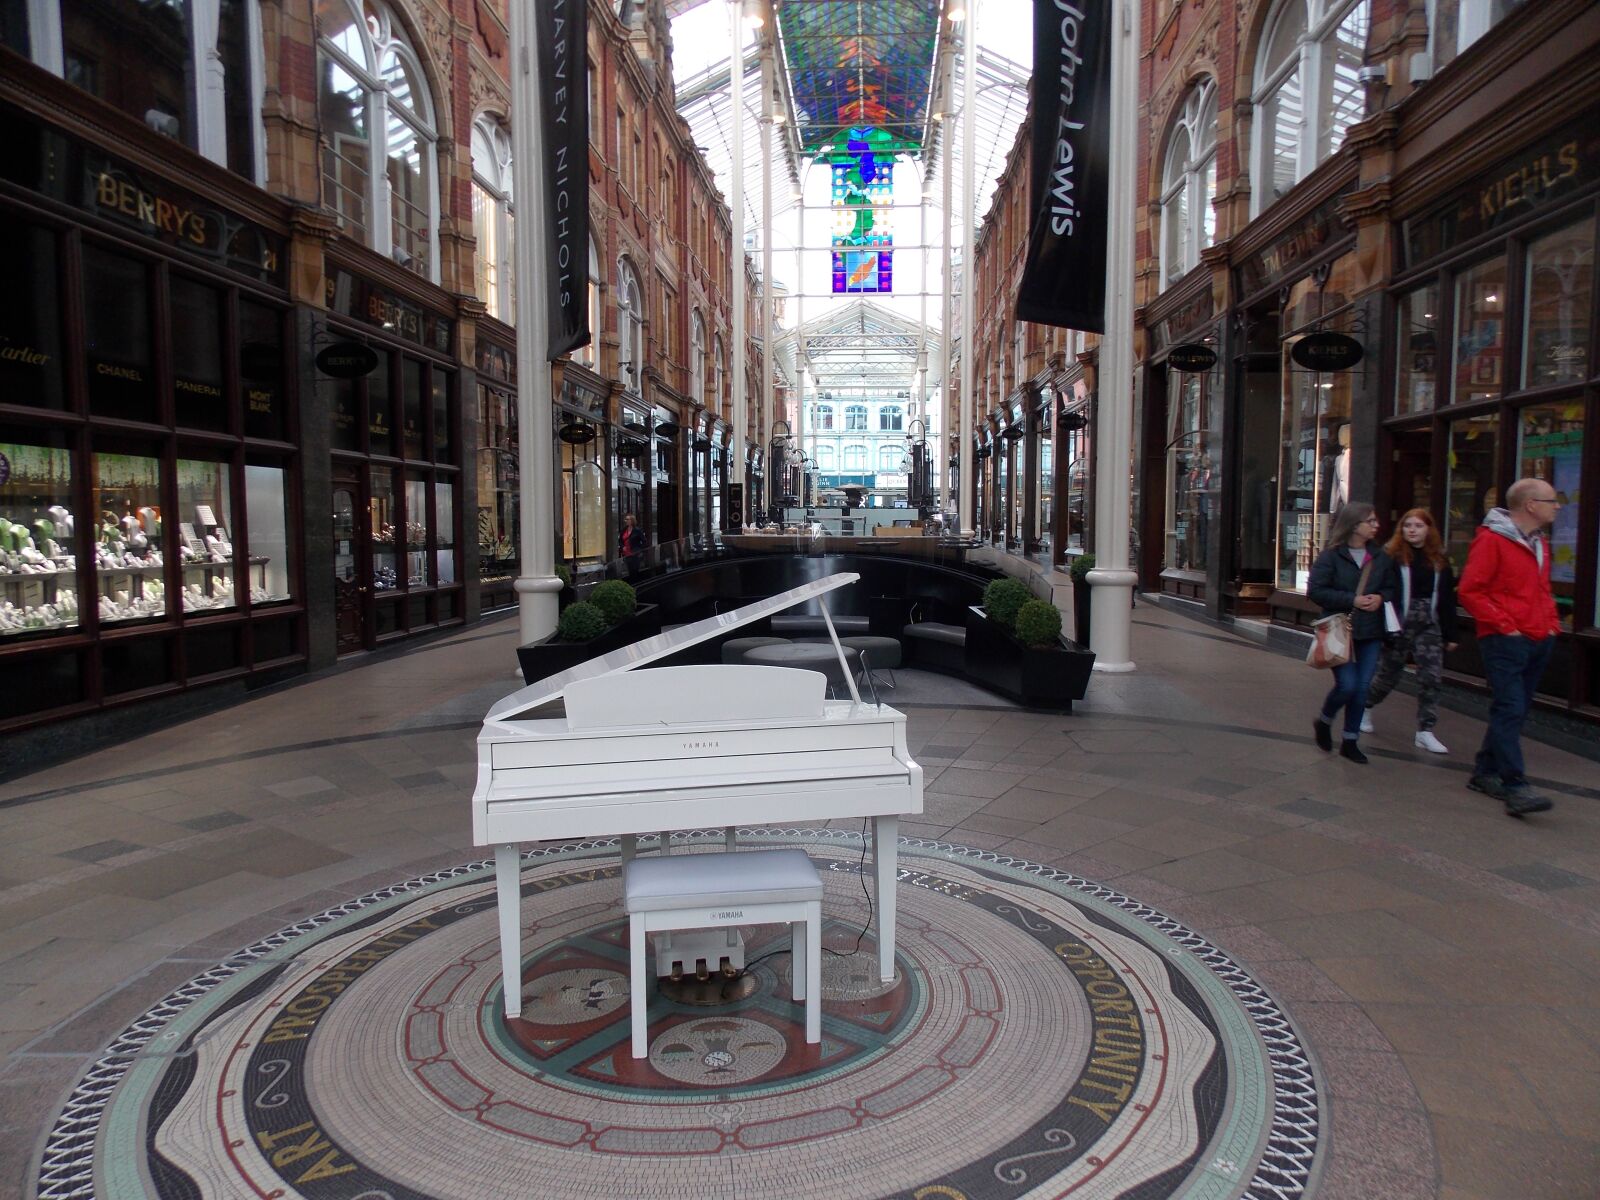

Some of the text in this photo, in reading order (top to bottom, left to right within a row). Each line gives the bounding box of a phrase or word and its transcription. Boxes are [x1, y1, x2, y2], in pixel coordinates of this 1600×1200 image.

[1051, 116, 1085, 237] Lewis
[556, 146, 571, 307] NICHOLS
[96, 362, 144, 382] CHANEL
[176, 380, 223, 397] PANERAI
[682, 741, 719, 749] YAMAHA
[718, 910, 744, 919] YAMAHA
[263, 917, 441, 1044] PROSPERITY
[1054, 941, 1146, 1124] OPPORTUNITY
[257, 1120, 358, 1184] ART
